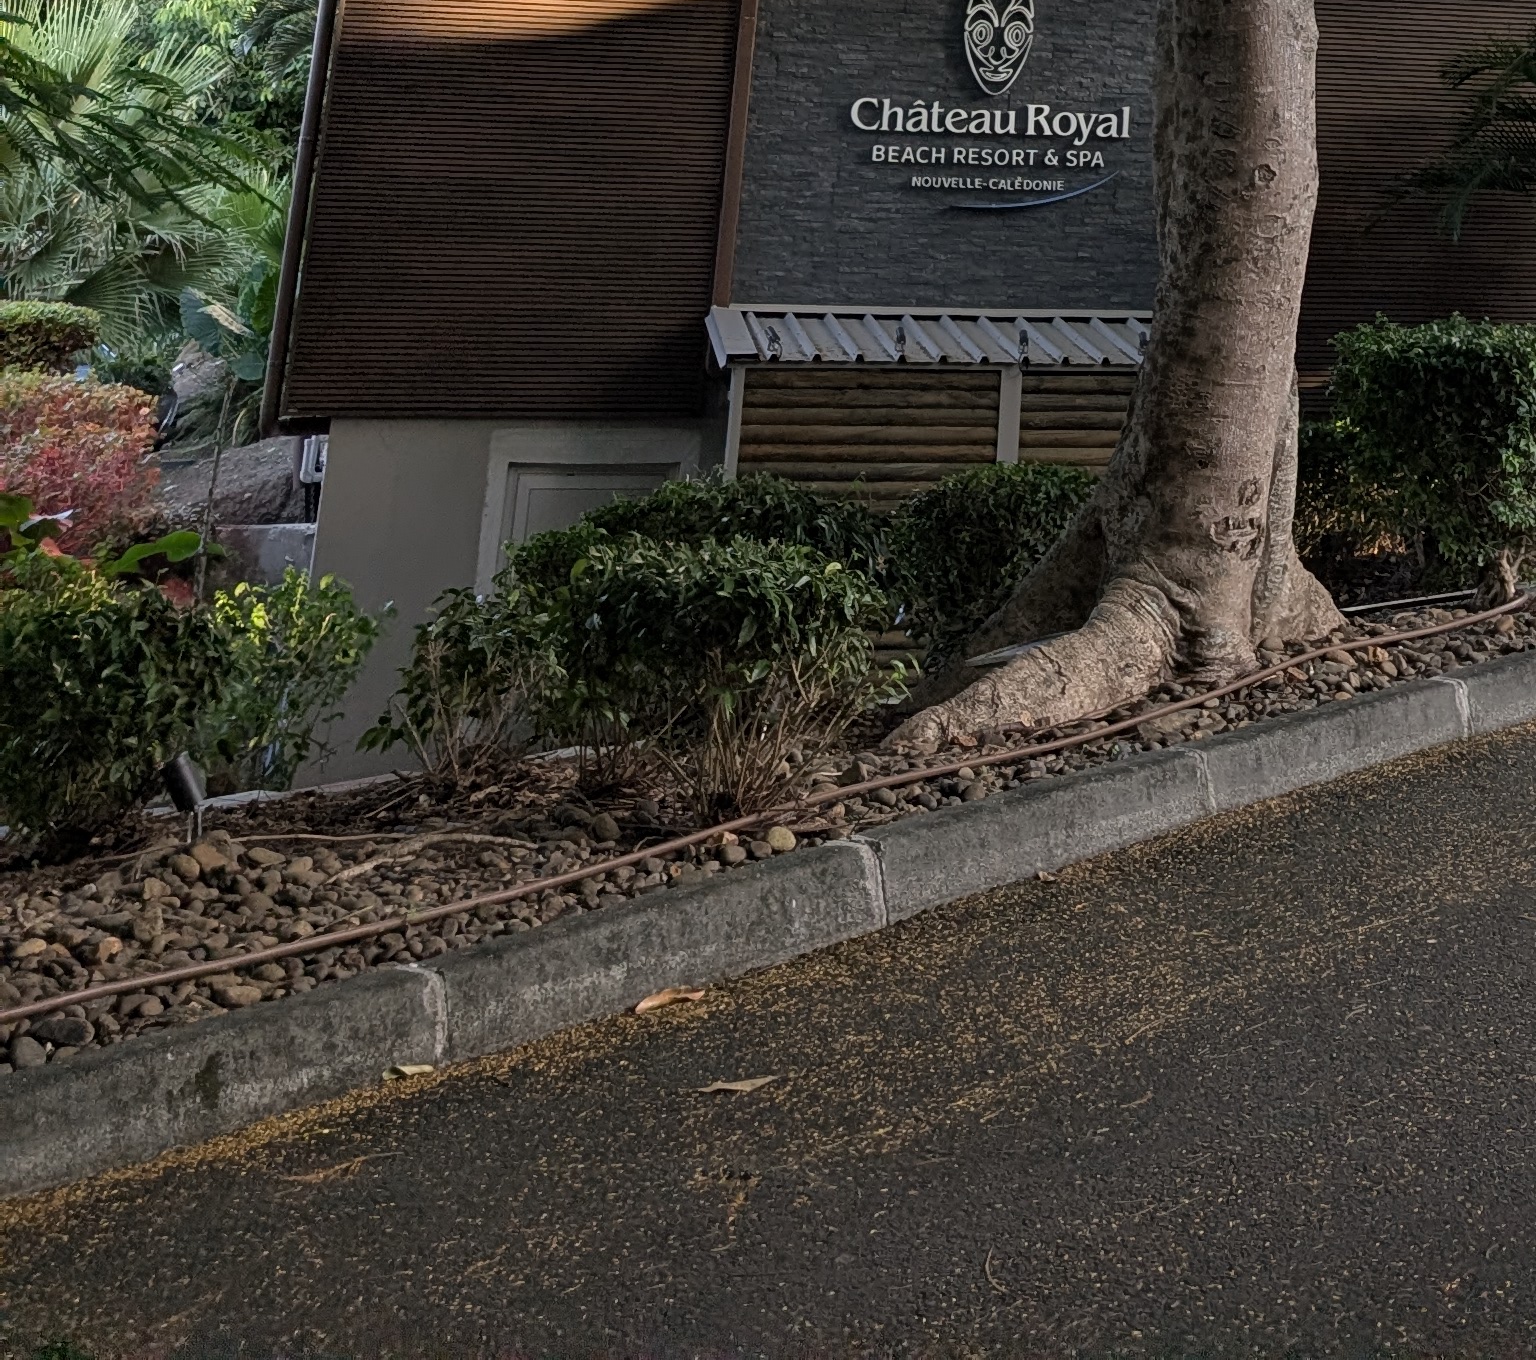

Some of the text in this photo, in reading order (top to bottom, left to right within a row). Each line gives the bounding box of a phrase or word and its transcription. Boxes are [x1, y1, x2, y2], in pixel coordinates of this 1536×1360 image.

[850, 97, 1131, 146] Château Royal
[871, 144, 1105, 168] BEACH RESORT & SPA
[911, 176, 1065, 192] NOUVELLE-CALÉDONIE
